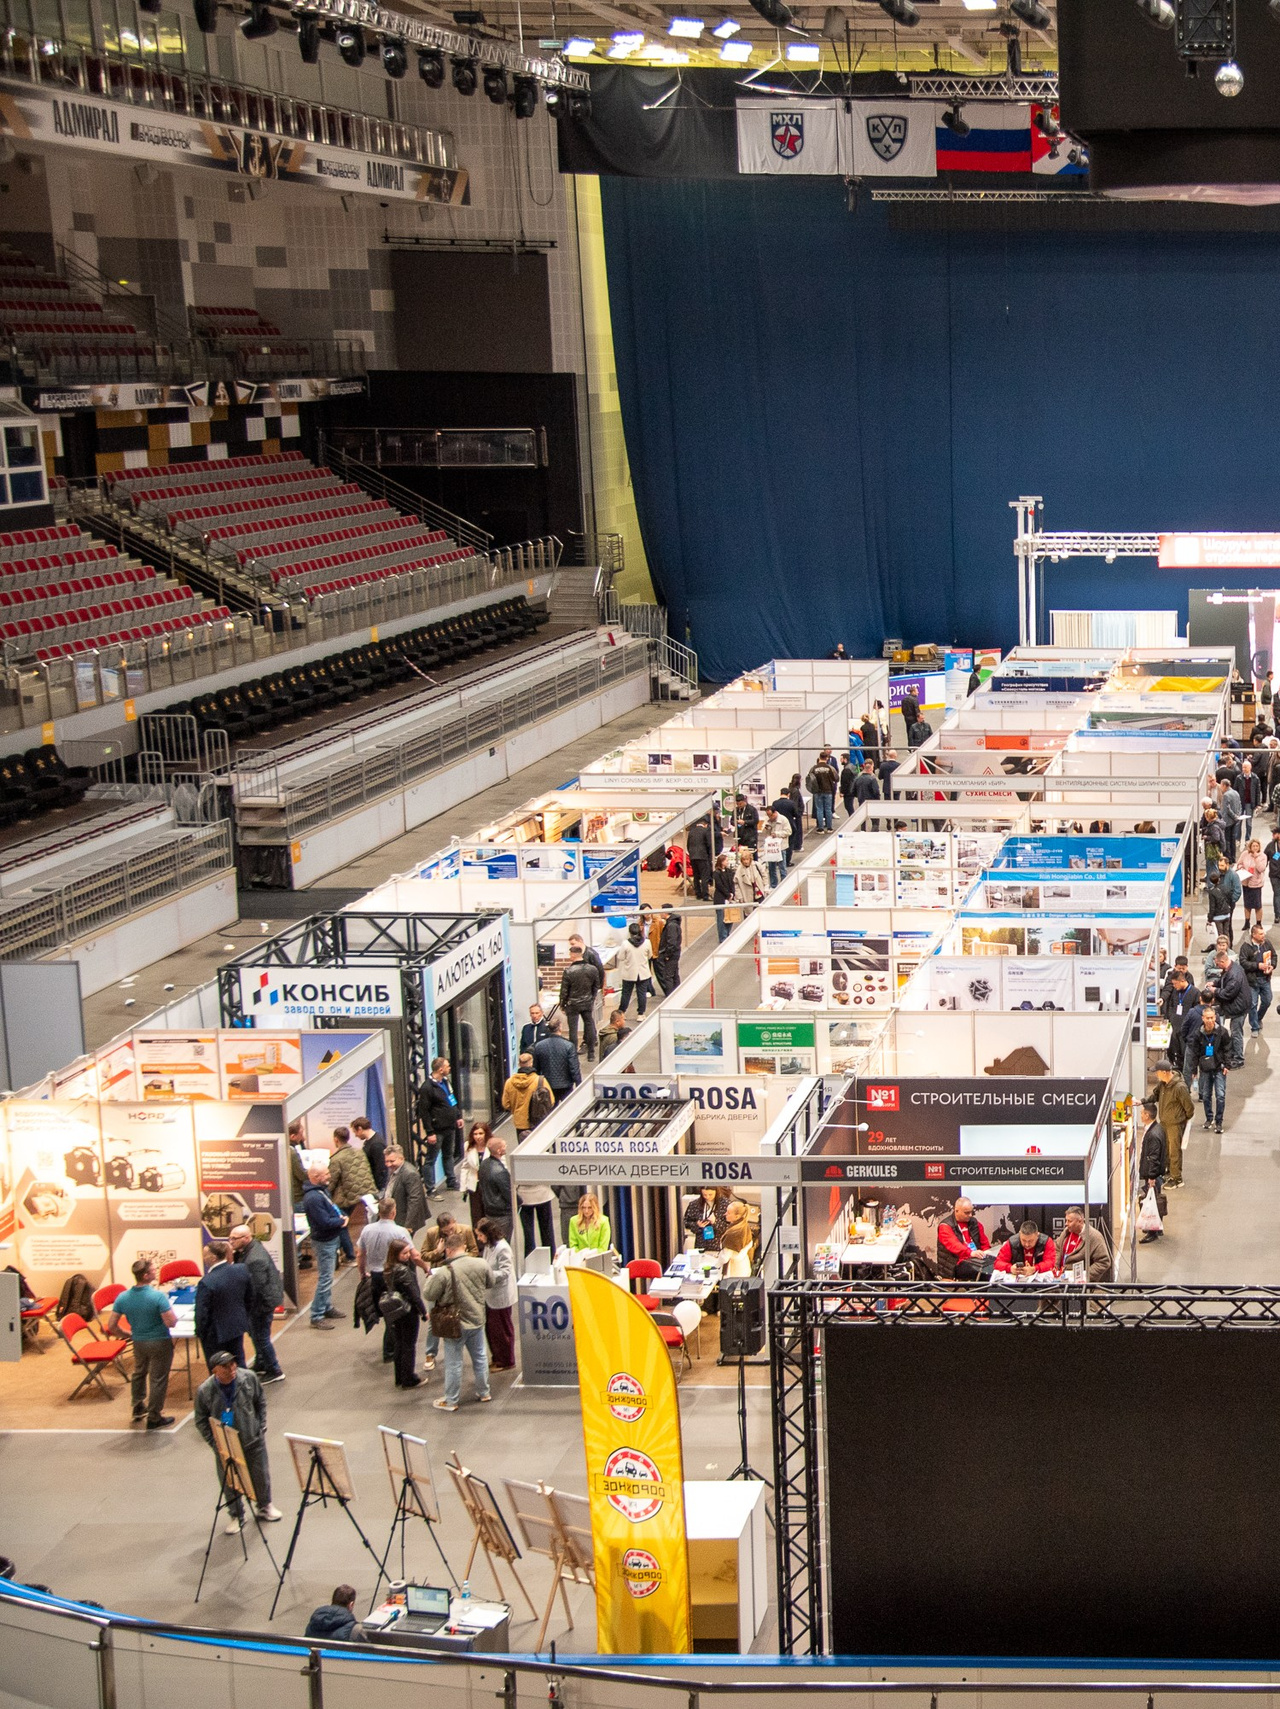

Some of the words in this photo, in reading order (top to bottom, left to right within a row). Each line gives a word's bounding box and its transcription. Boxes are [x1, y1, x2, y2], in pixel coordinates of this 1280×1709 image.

[53, 100, 120, 143] АДМИРАЛ
[773, 115, 801, 125] МХЛ
[139, 132, 192, 150] ВЛАДИВОСТОК
[367, 161, 404, 191] АДМИРАЛ
[1203, 538, 1251, 553] Шоурум
[437, 954, 476, 997] АЛЮТЕХ
[477, 947, 488, 963] SL
[488, 930, 503, 958] 160
[282, 983, 390, 1003] КОНСИБ
[284, 1005, 316, 1015] завод
[318, 1006, 344, 1015] оон
[345, 1006, 351, 1014] и
[354, 1005, 391, 1016] дверей
[690, 1086, 757, 1110] ROSA
[871, 1089, 896, 1101] №1
[910, 1092, 1035, 1106] СТРОИТЕЛЬНЫЕ
[1042, 1093, 1097, 1106] СМЕСИ
[727, 1112, 758, 1121] ДВЕРЕЙ
[868, 1131, 884, 1143] 29
[560, 1141, 589, 1153] ROSA
[595, 1140, 624, 1153] ROSA
[629, 1140, 658, 1153] ROSA
[558, 1164, 627, 1176] ФАБРИКА
[630, 1162, 690, 1177] ДВЕРЕЙ
[702, 1162, 752, 1179] ROSA
[846, 1165, 898, 1178] GERKULES
[928, 1165, 943, 1173] №1
[949, 1166, 1028, 1176] СТРОИТЕЛЬНЫЕ
[1029, 1166, 1064, 1175] СМЕСИ
[535, 1332, 571, 1342] фабрика
